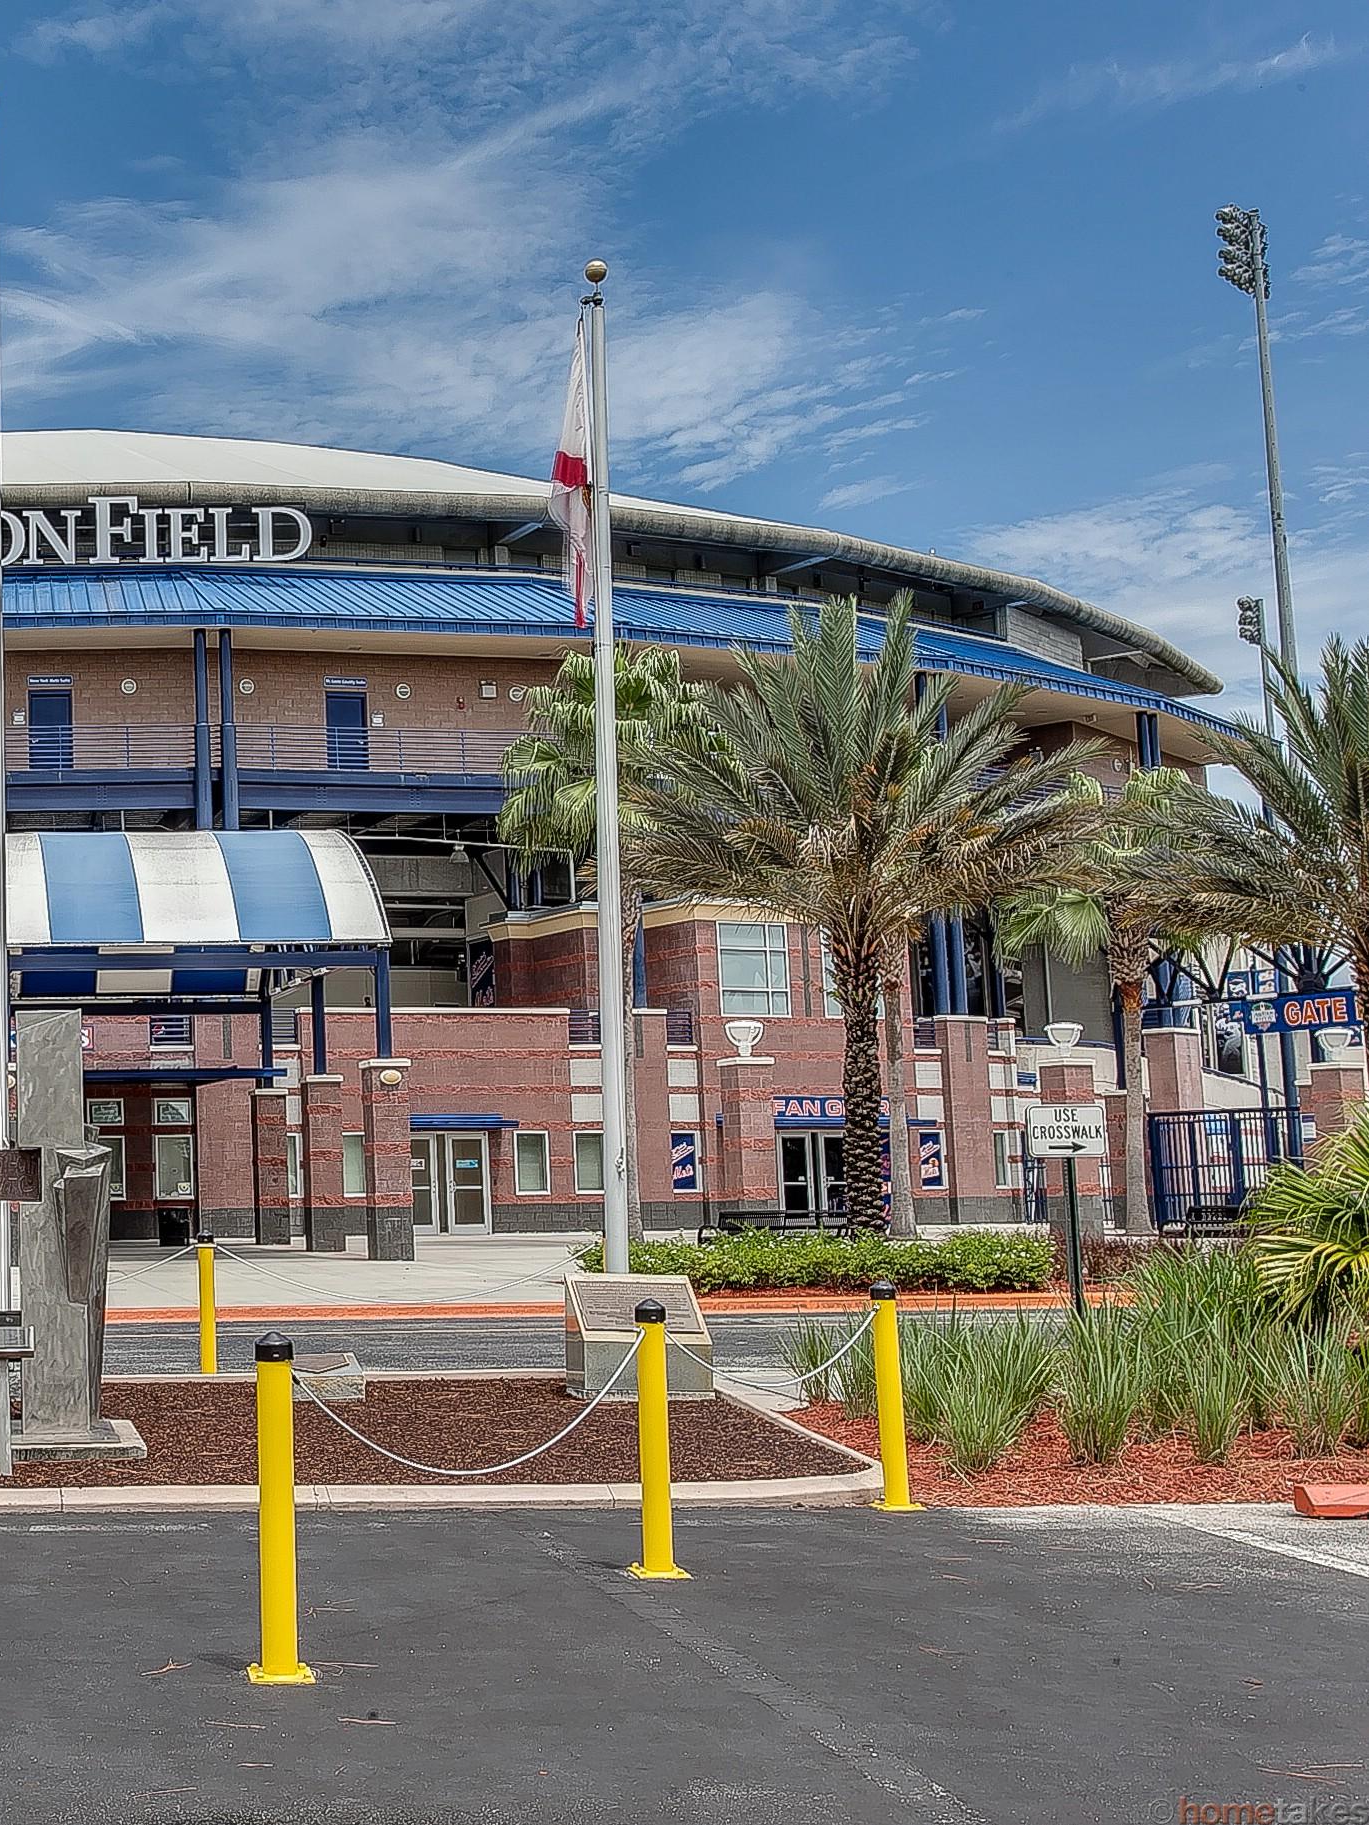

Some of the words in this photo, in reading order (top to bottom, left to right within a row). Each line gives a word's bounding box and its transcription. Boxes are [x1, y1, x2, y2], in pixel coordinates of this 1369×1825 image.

[1283, 996, 1348, 1027] GATE
[772, 1099, 821, 1117] FAN
[824, 1099, 891, 1117] GR
[1053, 1107, 1079, 1123] USE
[1032, 1124, 1103, 1140] CROSSWALK
